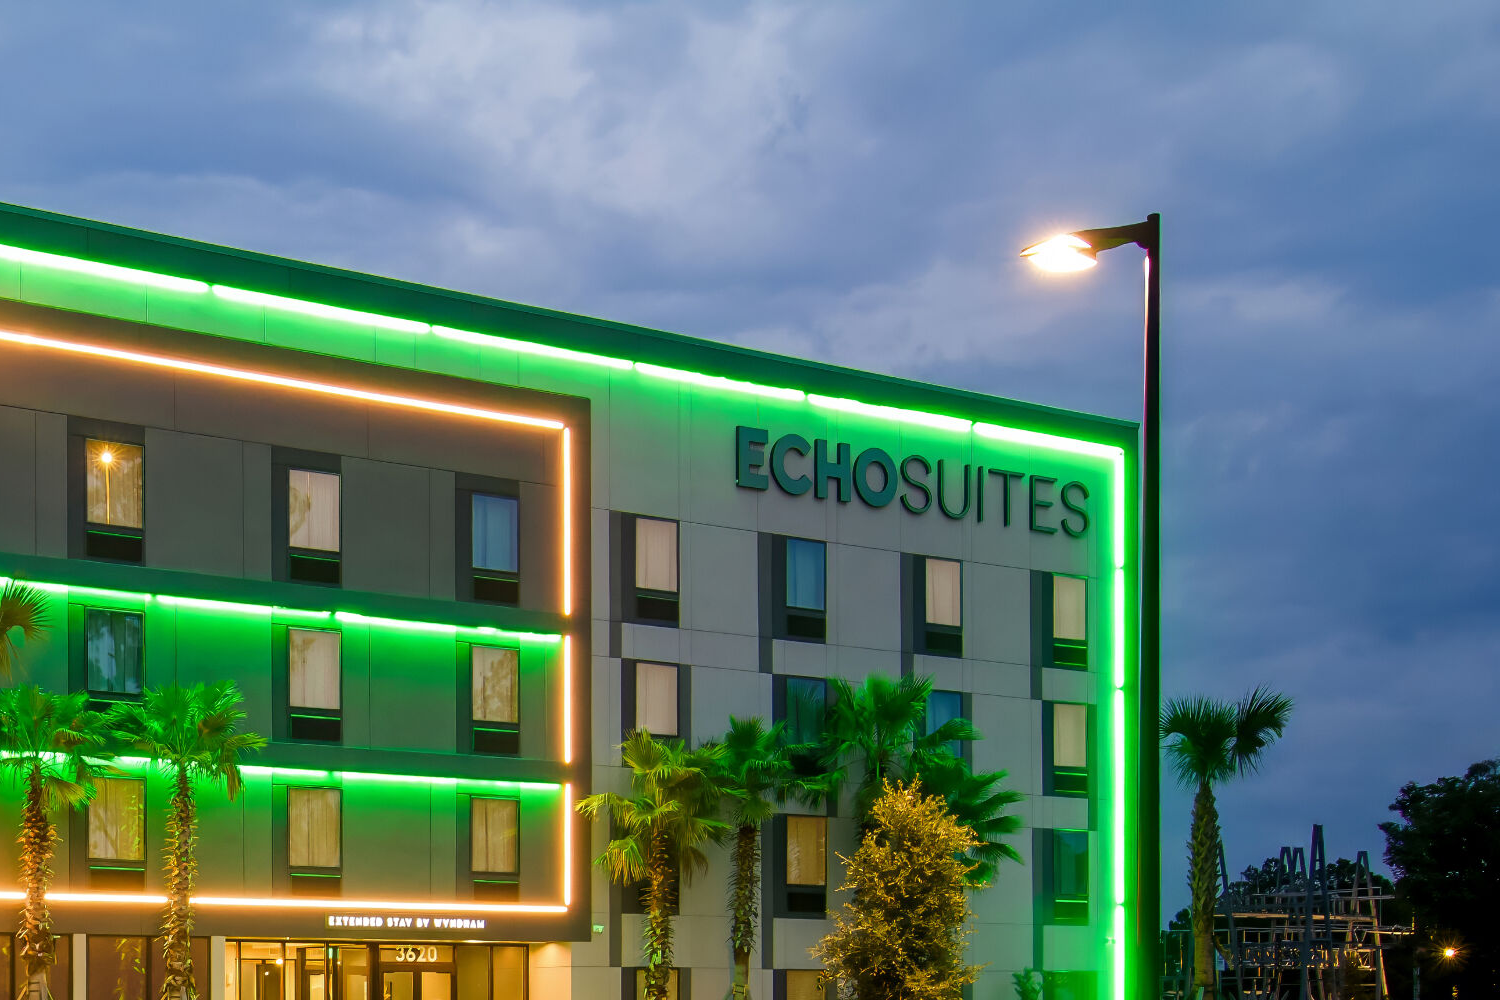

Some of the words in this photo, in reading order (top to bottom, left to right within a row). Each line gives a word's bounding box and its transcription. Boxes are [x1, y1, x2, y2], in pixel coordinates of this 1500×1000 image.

[328, 916, 383, 926] EXTENDED
[386, 917, 412, 927] STAY
[416, 918, 430, 928] BY
[434, 919, 485, 928] WYNDHAM
[396, 946, 437, 962] 3620
